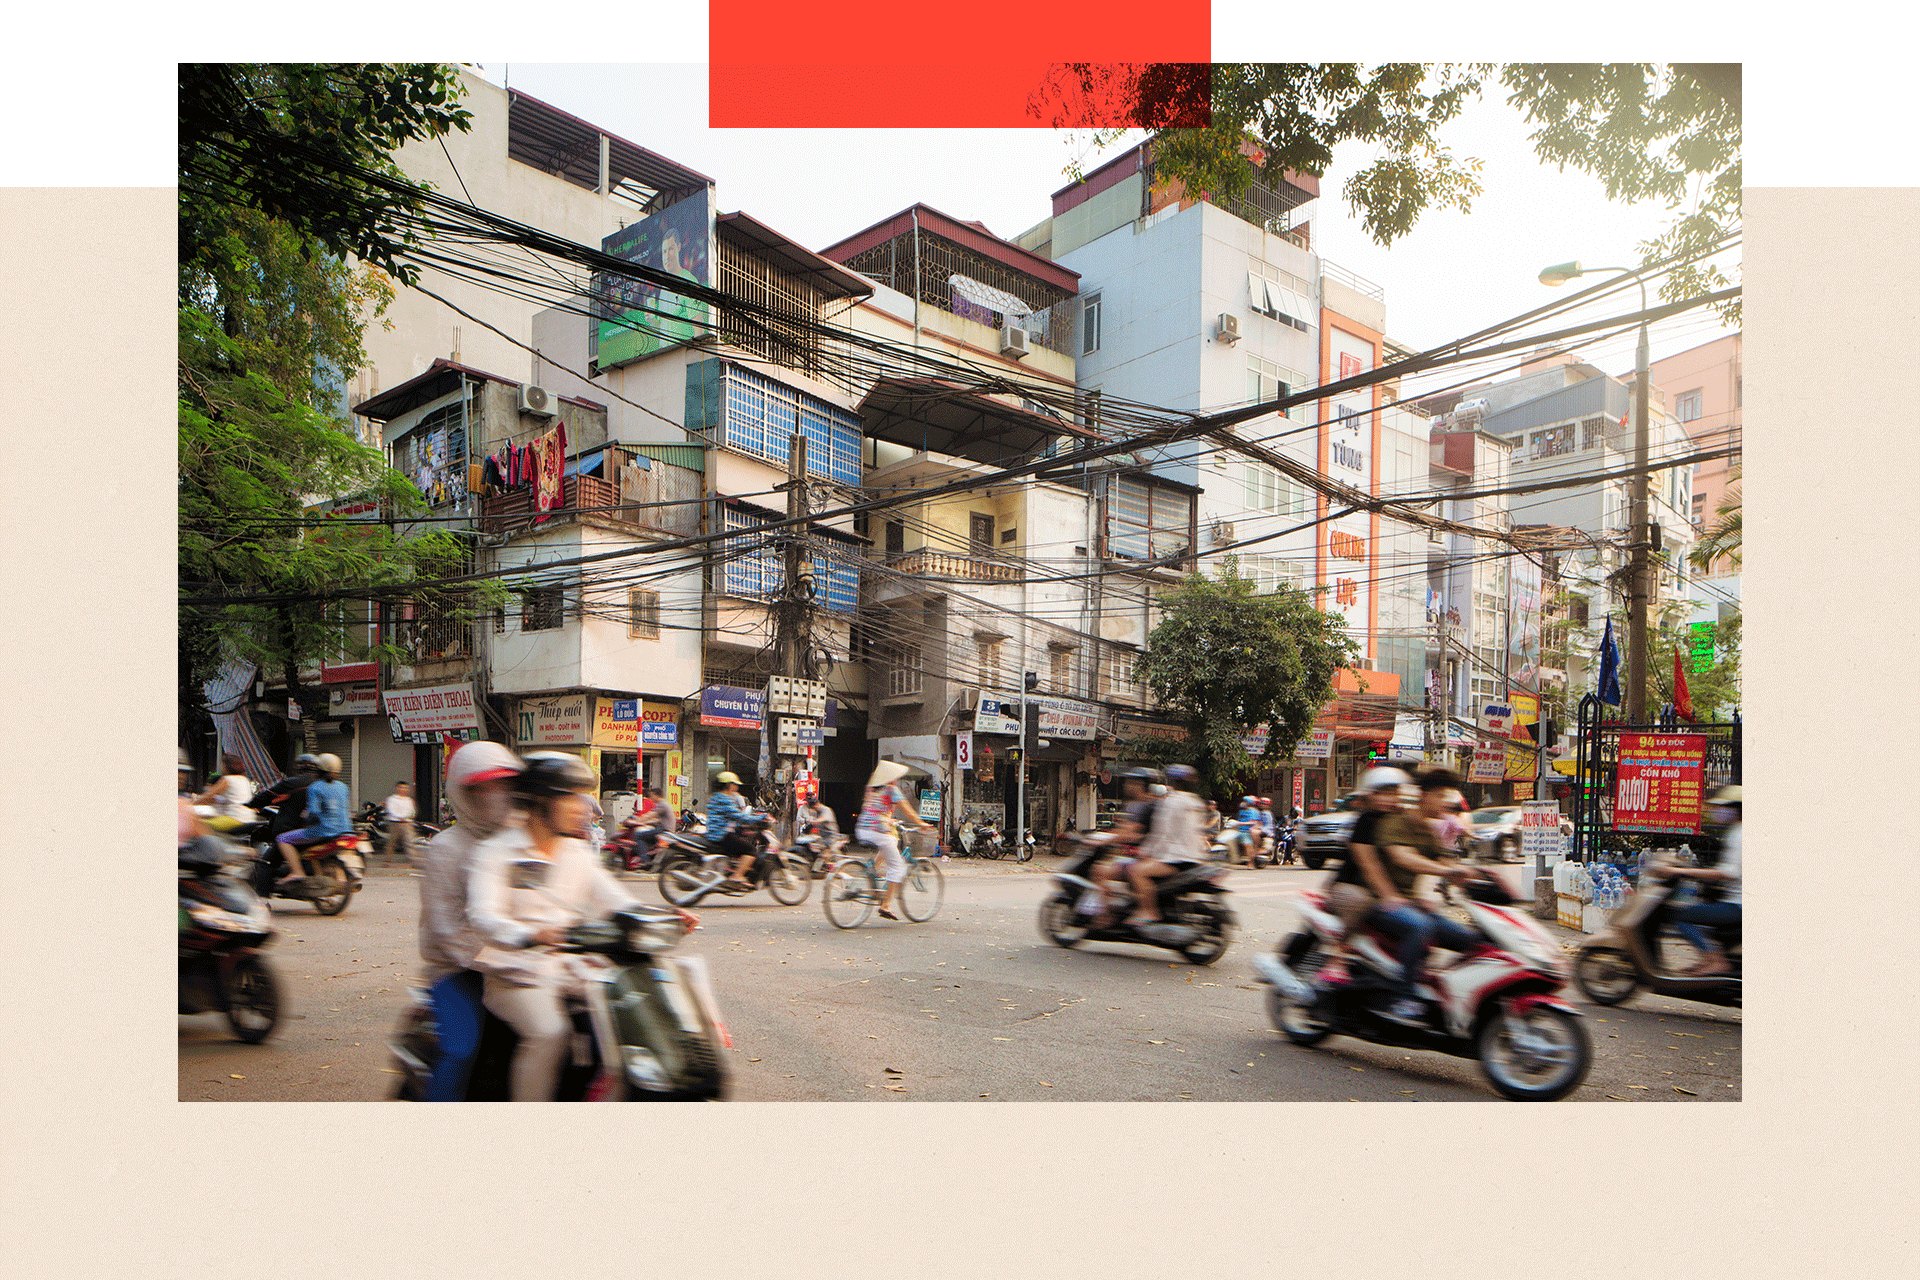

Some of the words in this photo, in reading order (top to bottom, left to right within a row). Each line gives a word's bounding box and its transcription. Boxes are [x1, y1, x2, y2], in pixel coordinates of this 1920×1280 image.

[614, 233, 647, 255] HERBALIFE
[386, 698, 402, 716] PHỤ
[402, 691, 423, 715] KIỆN
[423, 689, 445, 713] ĐIỆN
[444, 690, 472, 711] THOẠI
[745, 691, 761, 702] PHỤ
[714, 699, 742, 711] CHUYÊN
[987, 702, 996, 710] 3
[389, 717, 402, 738] 96
[1005, 723, 1019, 733] PHỤ
[1059, 725, 1071, 736] CÁC
[1072, 728, 1087, 738] LOẠI
[1639, 736, 1655, 748] 94
[1656, 738, 1667, 746] LÒ
[959, 740, 969, 763] 3
[672, 757, 679, 769] IN
[1640, 766, 1659, 777] CỒN
[1661, 769, 1680, 778] KHÔ
[1618, 776, 1649, 818] RƯỢU
